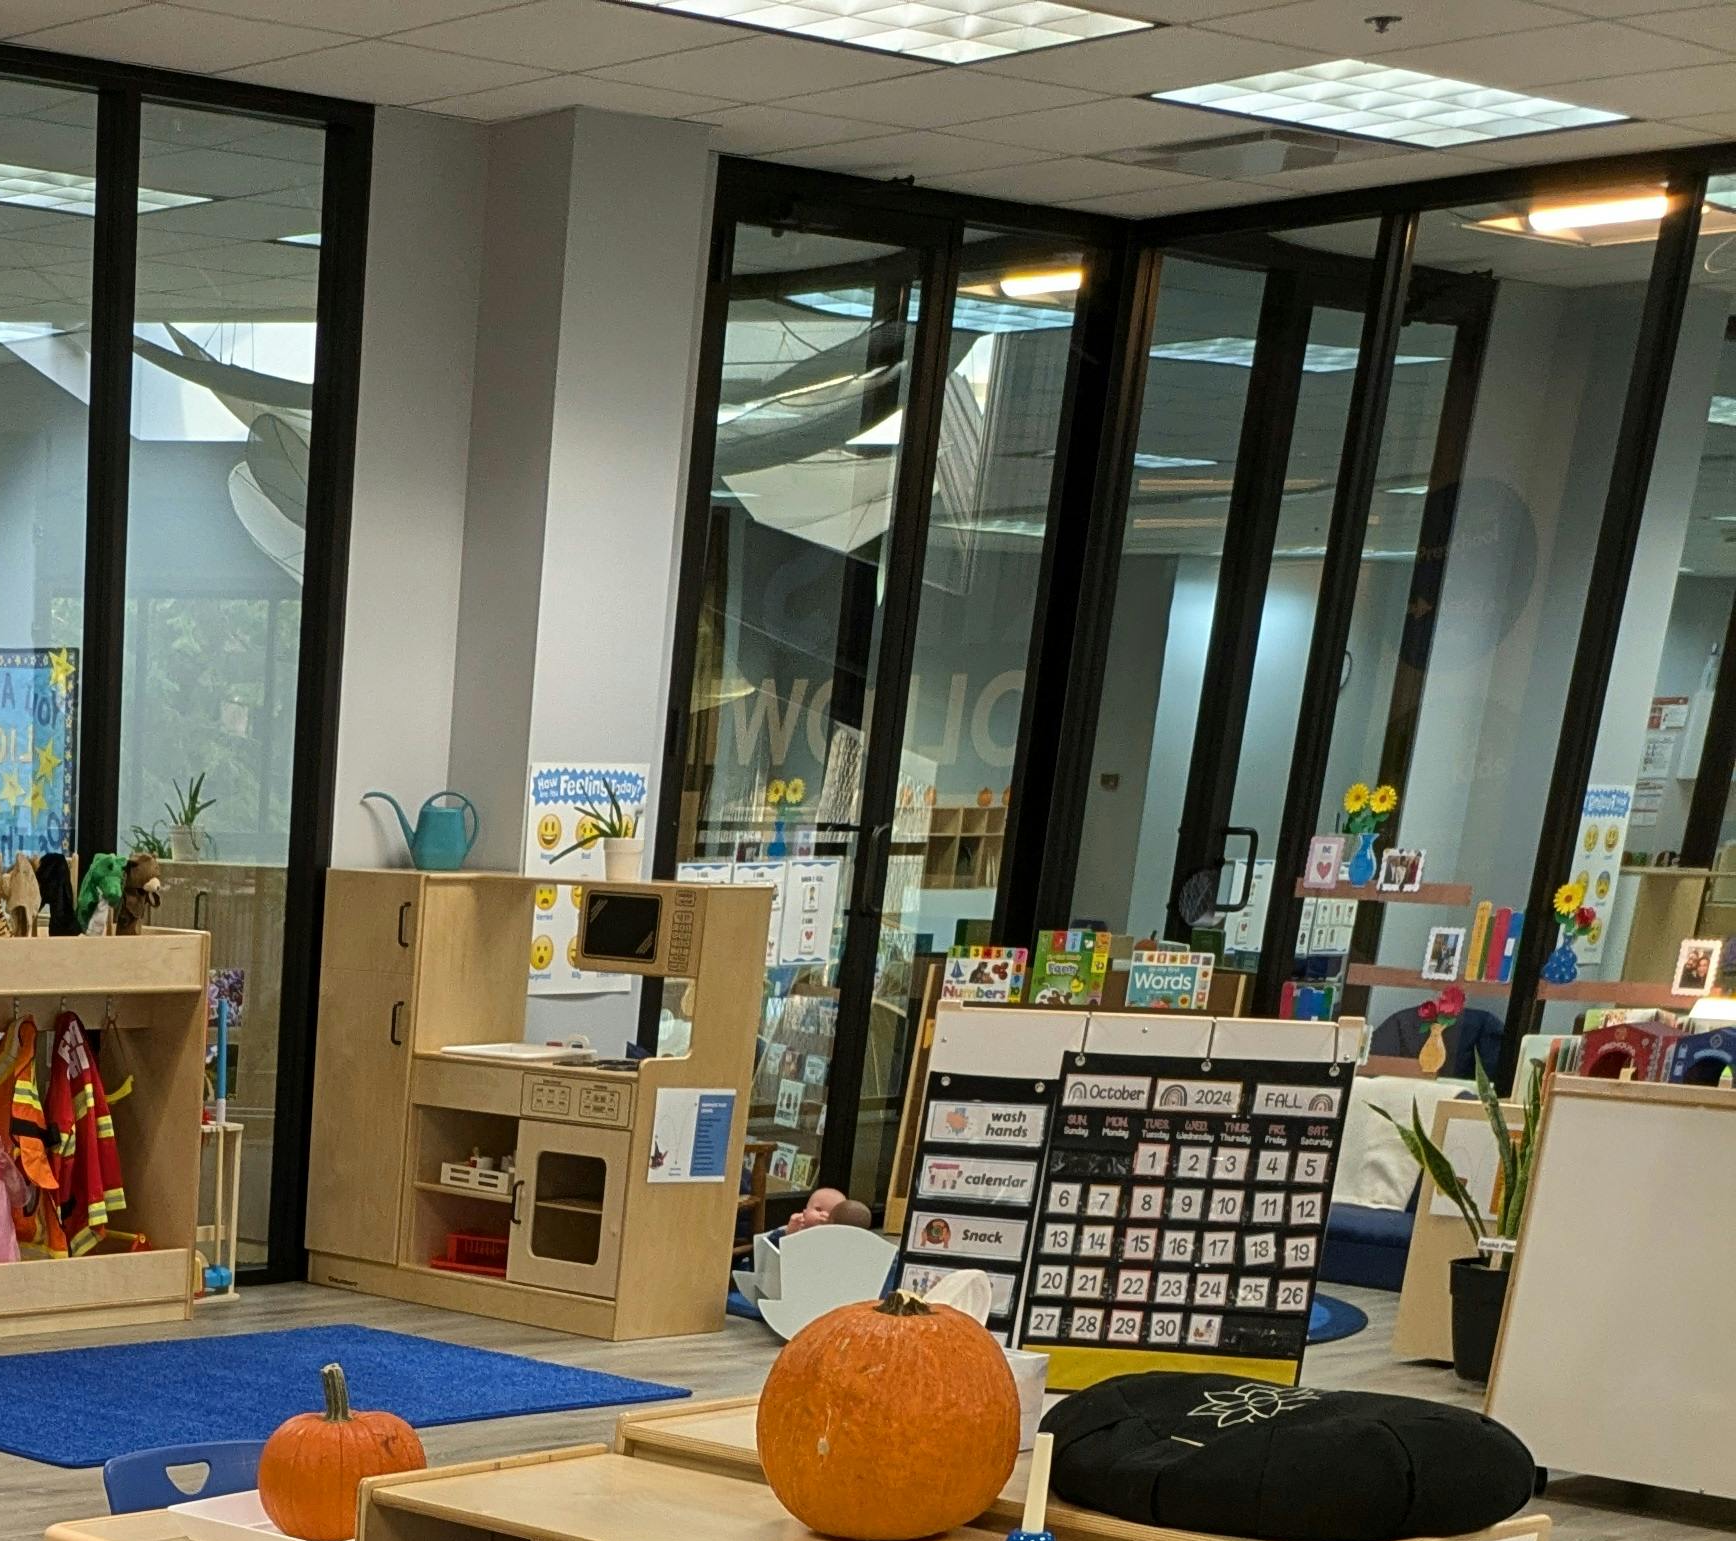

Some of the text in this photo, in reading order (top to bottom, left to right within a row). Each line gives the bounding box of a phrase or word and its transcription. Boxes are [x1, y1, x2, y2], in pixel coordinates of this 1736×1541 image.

[1134, 972, 1192, 990] Words
[943, 985, 1006, 999] Numbers
[1089, 1084, 1146, 1102] October
[1194, 1089, 1232, 1105] 2024
[1265, 1092, 1303, 1109] FALL
[991, 1110, 1027, 1124] wash
[985, 1124, 1028, 1138] hands
[1063, 1127, 1333, 1148] Sunday Monday Tuesday Wednesday Thursday Friday Saturday
[1148, 1152, 1317, 1176] 1 2 3 4 5
[964, 1174, 1028, 1188] calendar
[1058, 1190, 1315, 1218] 6 7 8 9 10 11 12
[962, 1228, 1004, 1244] Snack
[1050, 1230, 1310, 1261] 13 14 15 16 17 18 19
[1041, 1272, 1303, 1304] 20 21 22 23 24 25 26
[1032, 1313, 1177, 1336] 27 28 29 30
